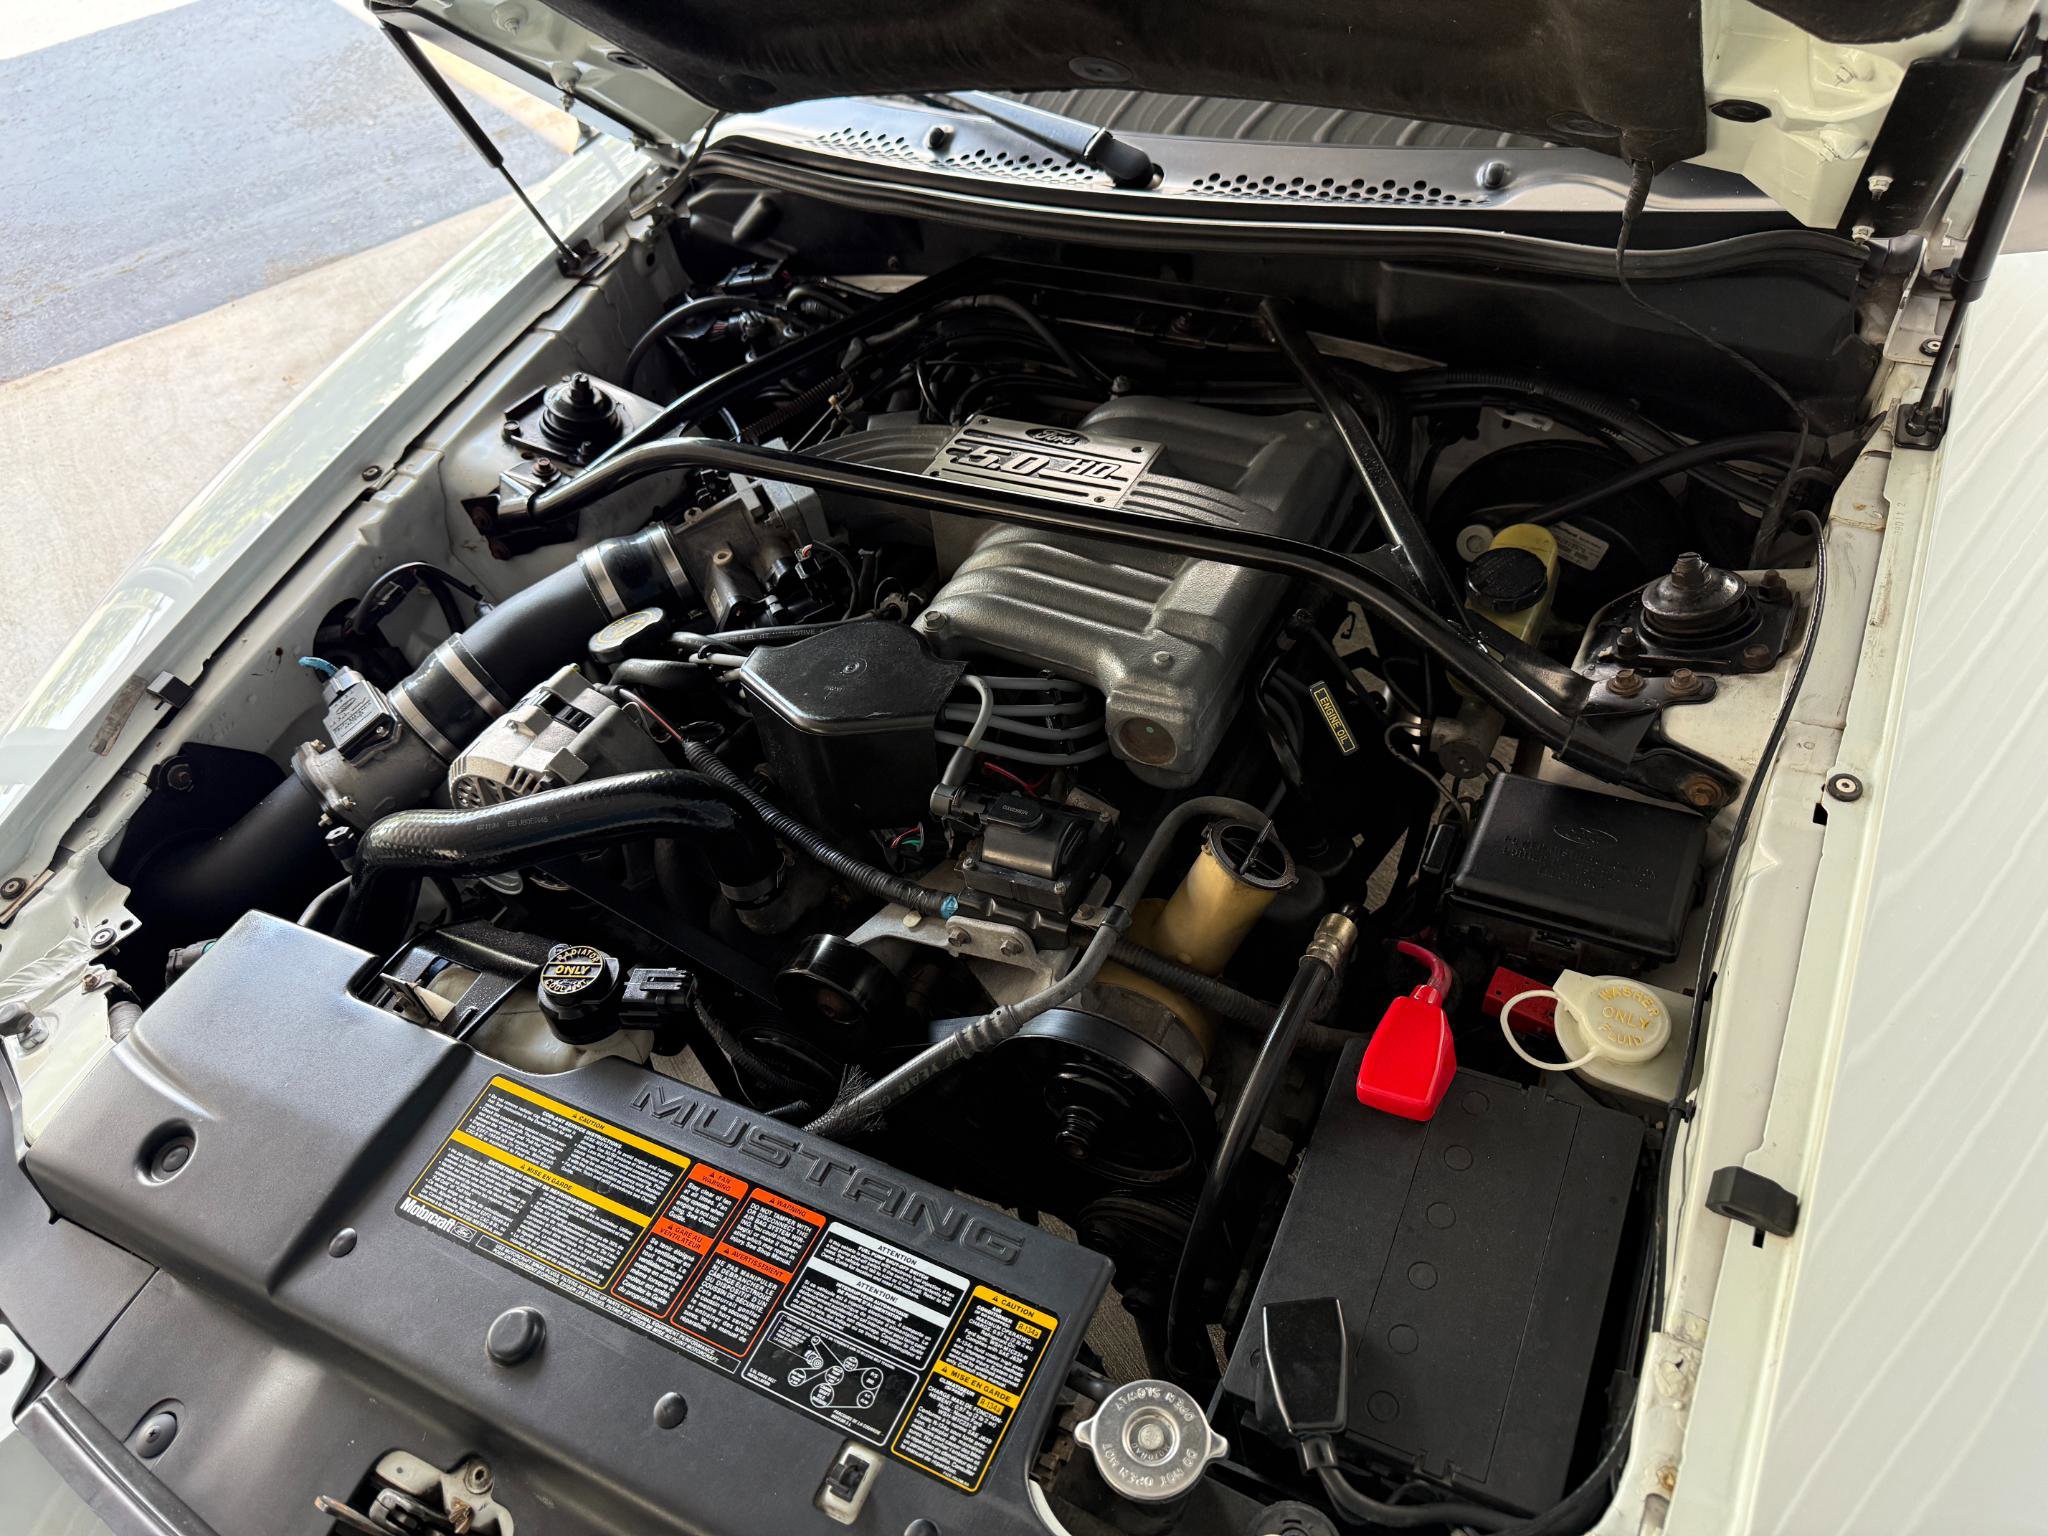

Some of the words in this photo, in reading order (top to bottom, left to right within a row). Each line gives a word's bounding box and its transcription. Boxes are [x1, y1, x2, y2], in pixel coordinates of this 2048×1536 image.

[1035, 428, 1081, 446] Ford
[959, 445, 1050, 477] 5.0
[1319, 696, 1341, 728] ENGINE
[1336, 729, 1350, 745] OIL
[556, 948, 602, 963] RADIATOR
[554, 964, 591, 975] ONLY
[1599, 985, 1662, 1017] WASHER
[1602, 1006, 1652, 1030] ONLY
[1599, 1023, 1645, 1048] FLUID
[577, 1115, 605, 1129] CAUTION
[525, 1166, 543, 1177] MISE
[541, 1173, 552, 1181] EN
[550, 1177, 573, 1191] GARDE
[630, 1082, 1025, 1265] MUSTANG
[701, 1175, 731, 1191] WARNING
[717, 1175, 731, 1184] FAN
[398, 1196, 456, 1232] Motorcraft
[775, 1200, 807, 1217] WARNING
[658, 1227, 701, 1250] VENTILATEUR
[674, 1227, 693, 1238] GARE
[730, 1250, 784, 1277] AVERTISSEMENT
[876, 1245, 917, 1265] ATTENTION
[1000, 1299, 1035, 1317] CAUTION
[949, 1370, 971, 1384] MISE
[970, 1379, 984, 1390] EN
[983, 1385, 1011, 1403] GARDE
[1117, 1466, 1155, 1488] OPEN
